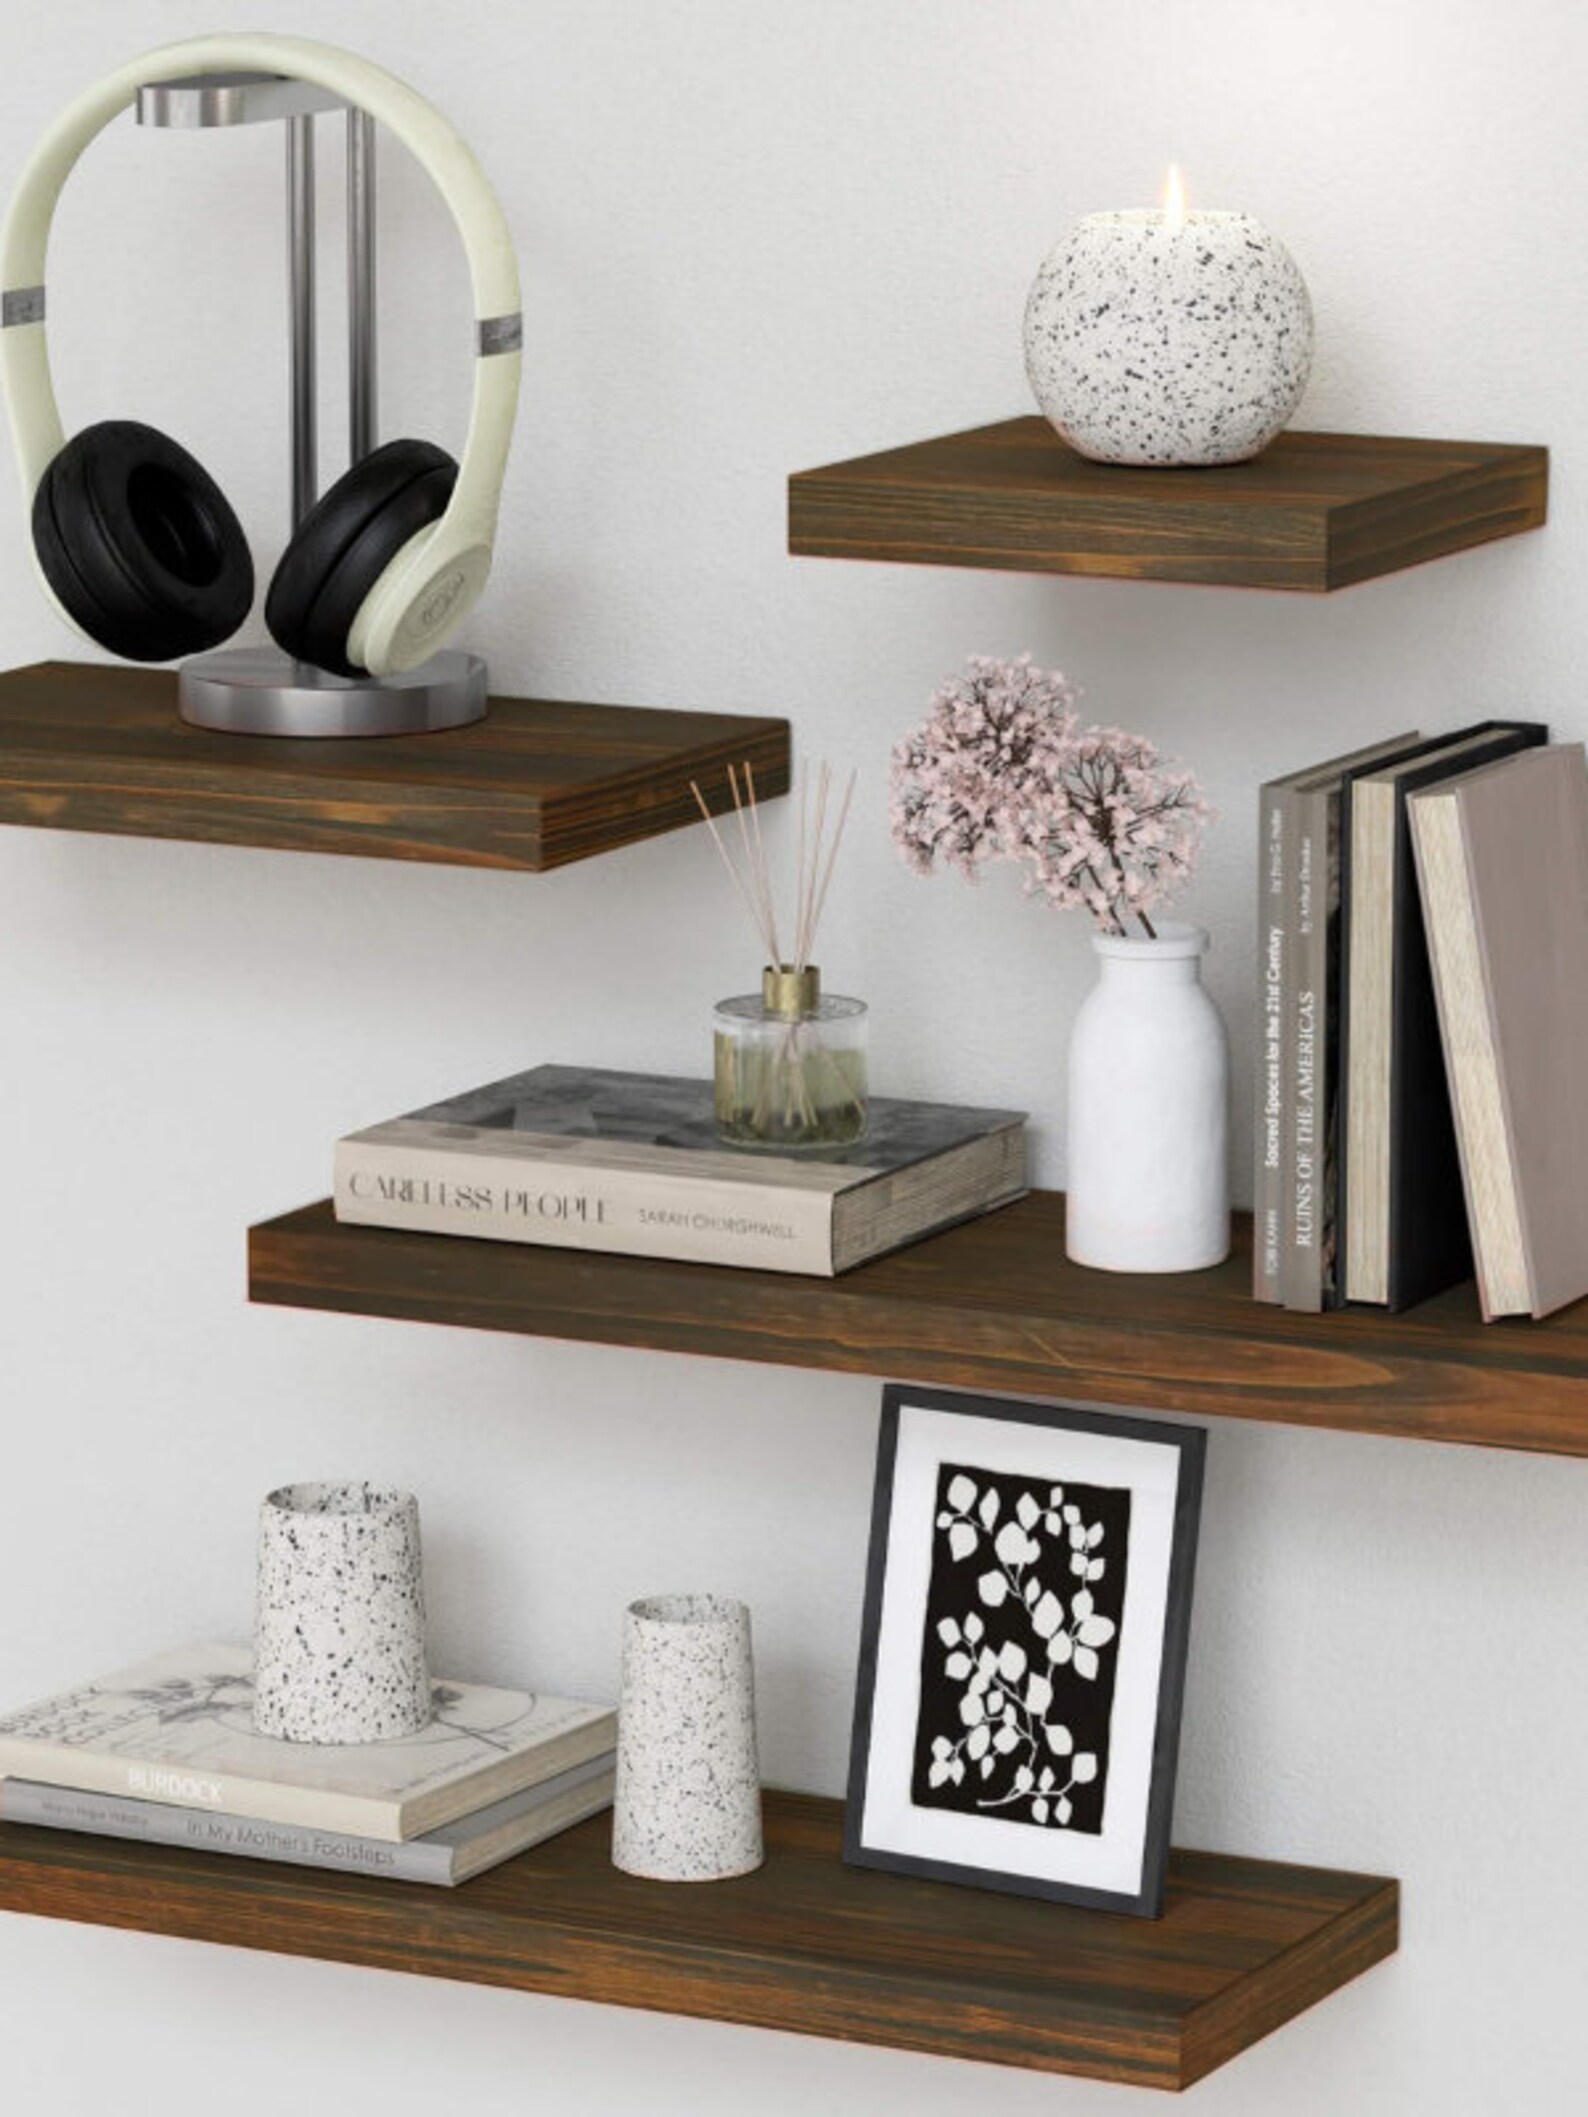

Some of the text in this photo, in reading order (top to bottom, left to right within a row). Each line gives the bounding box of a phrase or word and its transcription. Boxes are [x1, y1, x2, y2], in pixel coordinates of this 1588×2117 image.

[1264, 925, 1284, 1168] Sacred Spaces for the 21st Century
[1295, 991, 1314, 1248] RUINS OF THE AMERICAS
[349, 1172, 606, 1224] CARELESS PEOPLE
[639, 1208, 689, 1229] SARAH
[128, 1767, 223, 1803] BURDOCK
[186, 1819, 202, 1834] In
[208, 1822, 233, 1844] My
[313, 1837, 395, 1866] Footsteps
